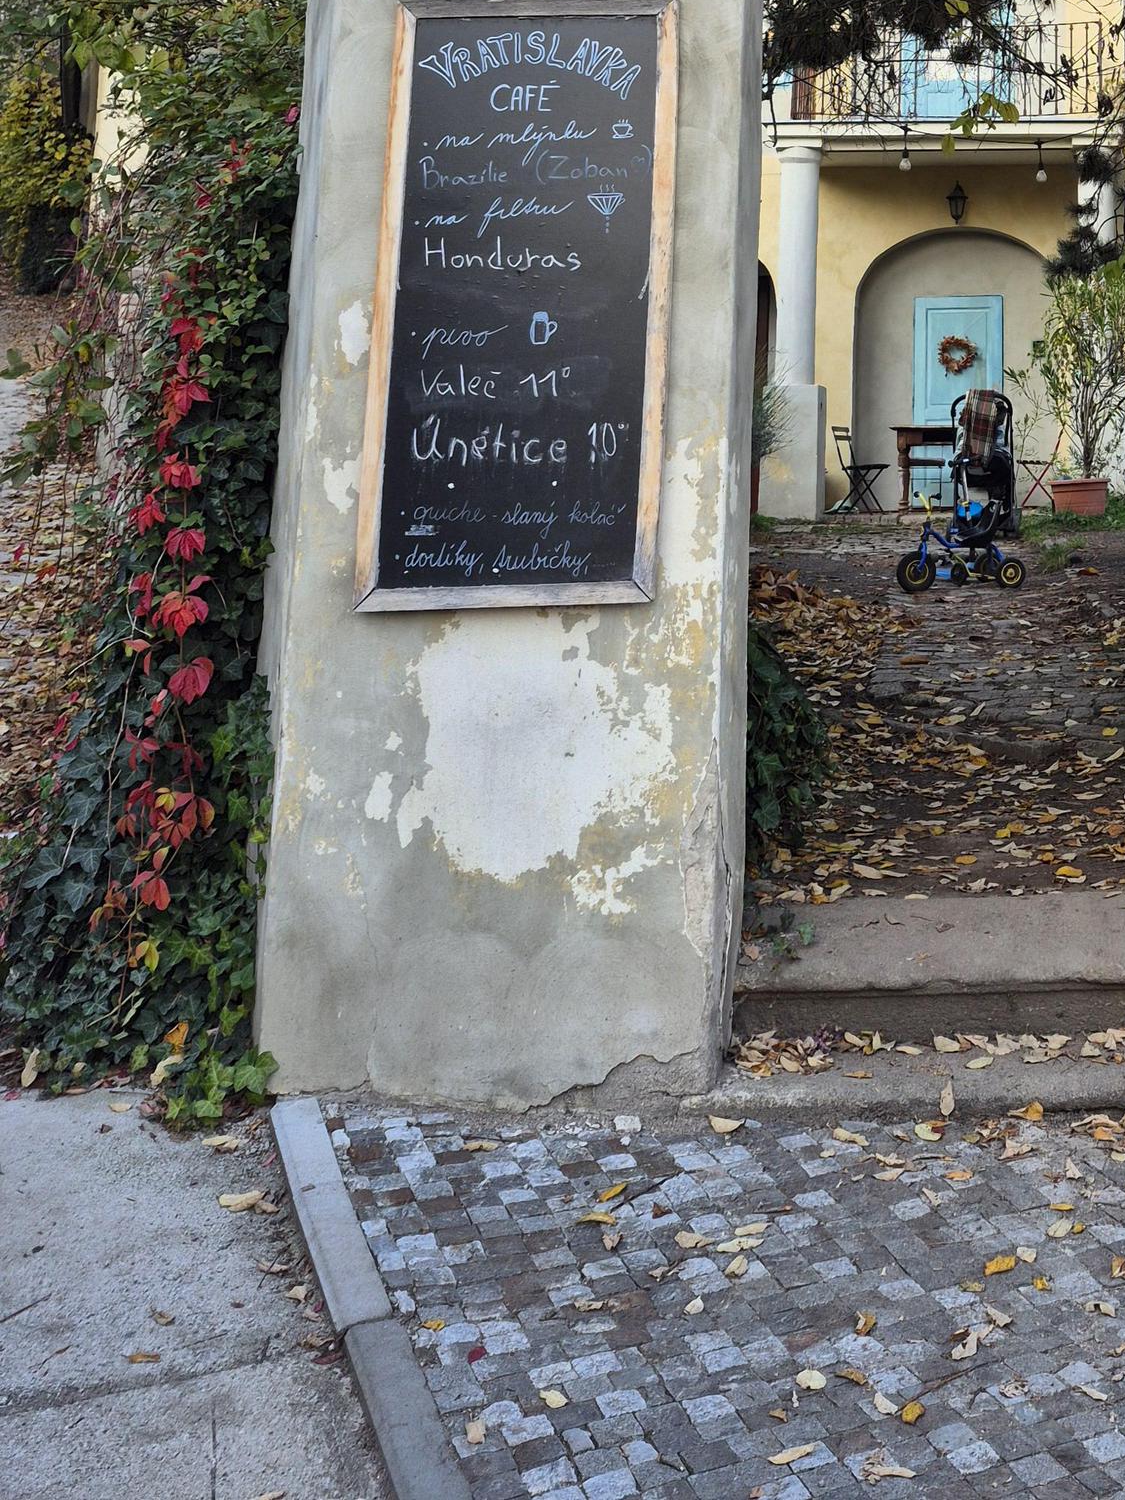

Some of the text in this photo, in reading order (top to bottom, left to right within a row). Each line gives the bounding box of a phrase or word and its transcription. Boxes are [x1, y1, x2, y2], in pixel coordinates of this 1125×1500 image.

[418, 30, 642, 101] VRATISLAVKA
[489, 80, 561, 112] CAFÉ
[434, 132, 485, 151] na
[424, 213, 471, 228] na
[424, 235, 583, 271] Honduras
